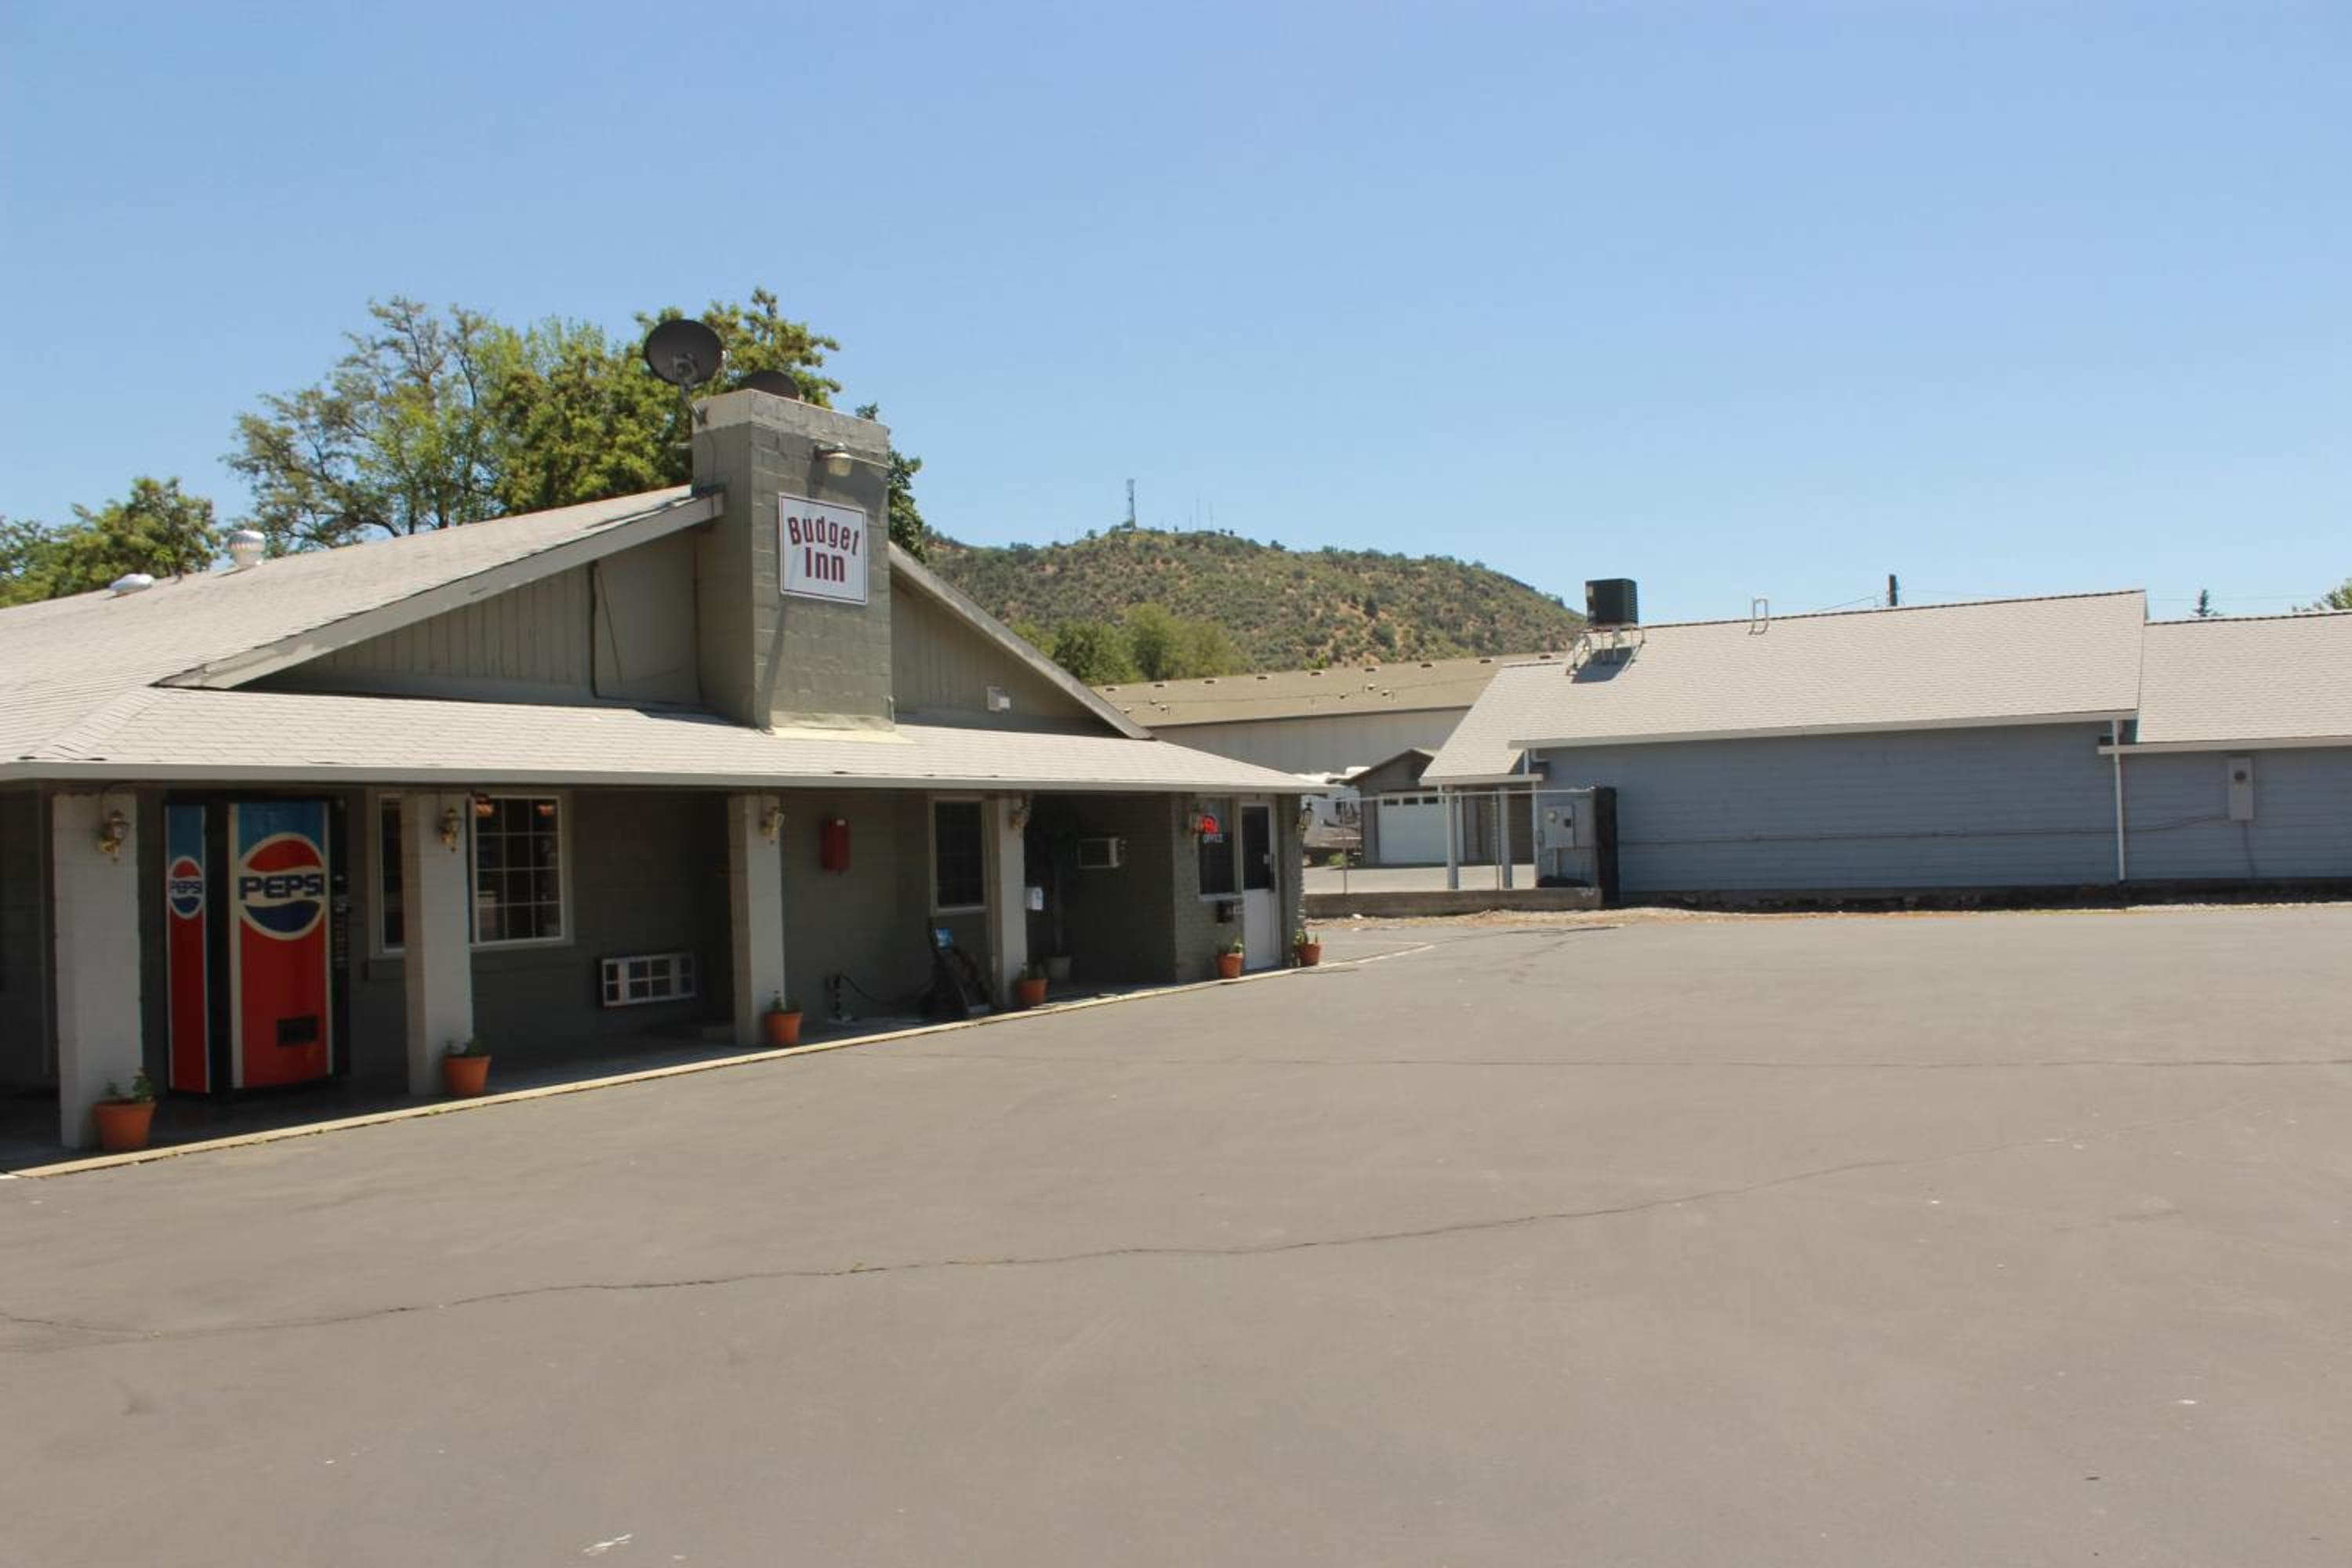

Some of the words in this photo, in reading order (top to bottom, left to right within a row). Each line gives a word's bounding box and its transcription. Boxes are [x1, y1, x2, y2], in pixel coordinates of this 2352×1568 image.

[788, 516, 859, 556] Budget
[805, 546, 845, 583] Inn
[239, 873, 325, 899] PEPSI
